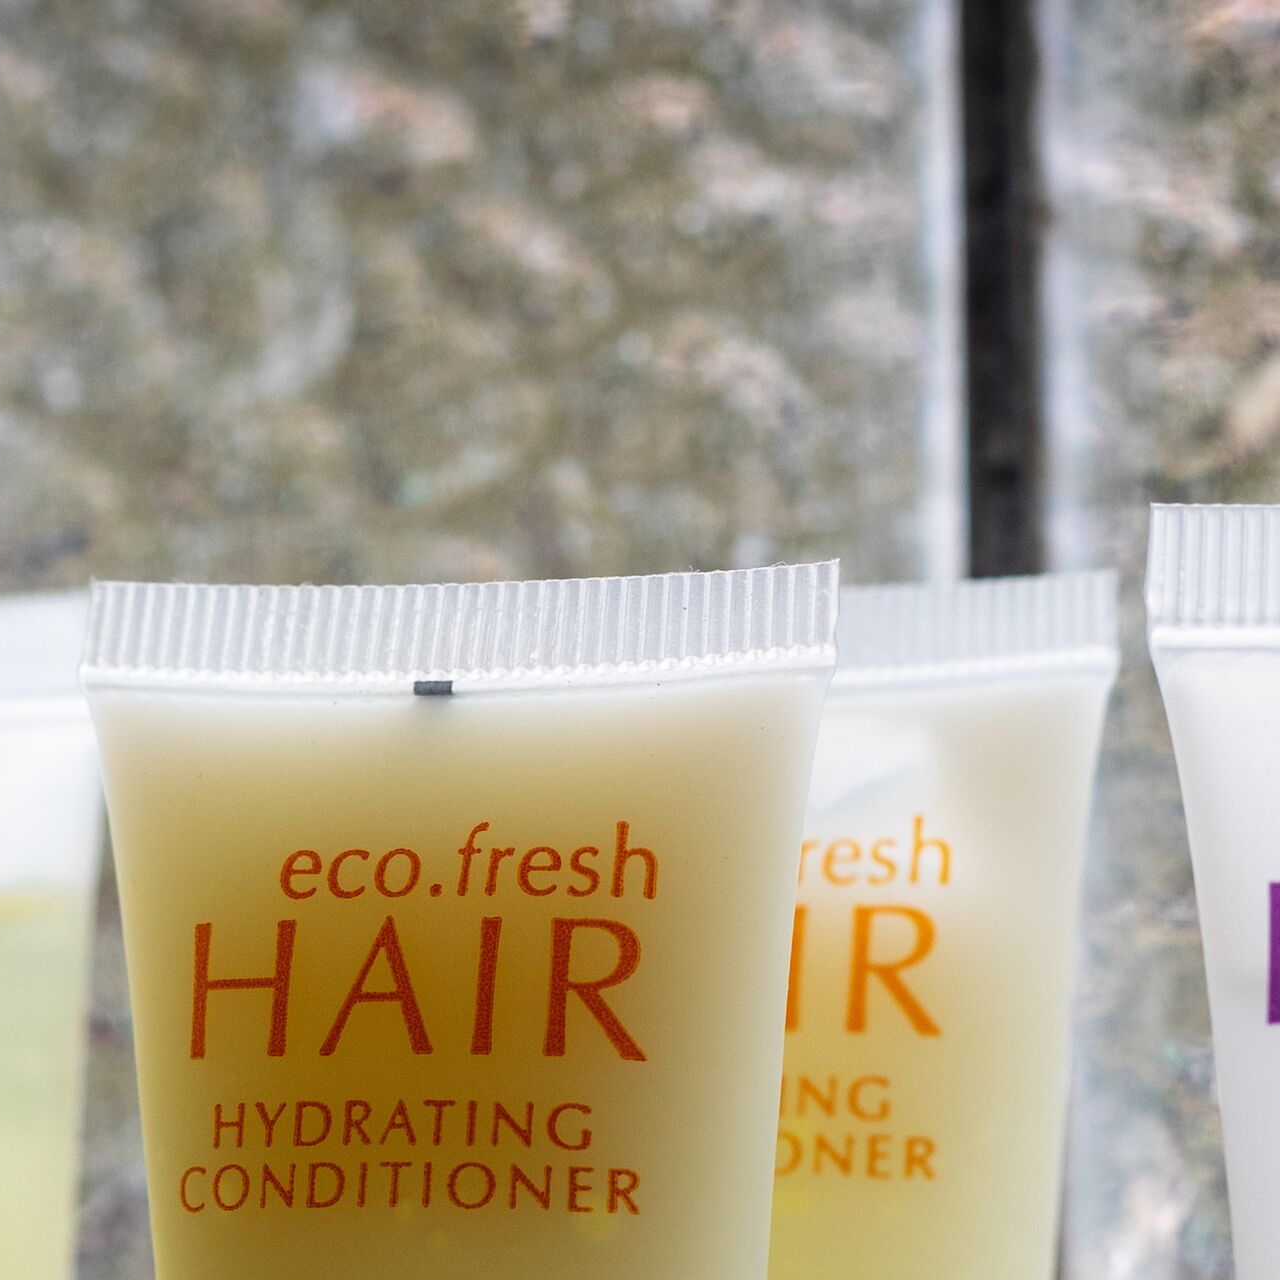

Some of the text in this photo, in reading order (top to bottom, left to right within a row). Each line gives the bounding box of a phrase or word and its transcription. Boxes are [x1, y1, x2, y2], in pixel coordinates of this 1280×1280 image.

[279, 820, 658, 899] eco.fresh
[188, 915, 647, 1062] HAIR
[212, 1098, 594, 1152] HYDRATING
[179, 1160, 641, 1216] CONDITIONER
